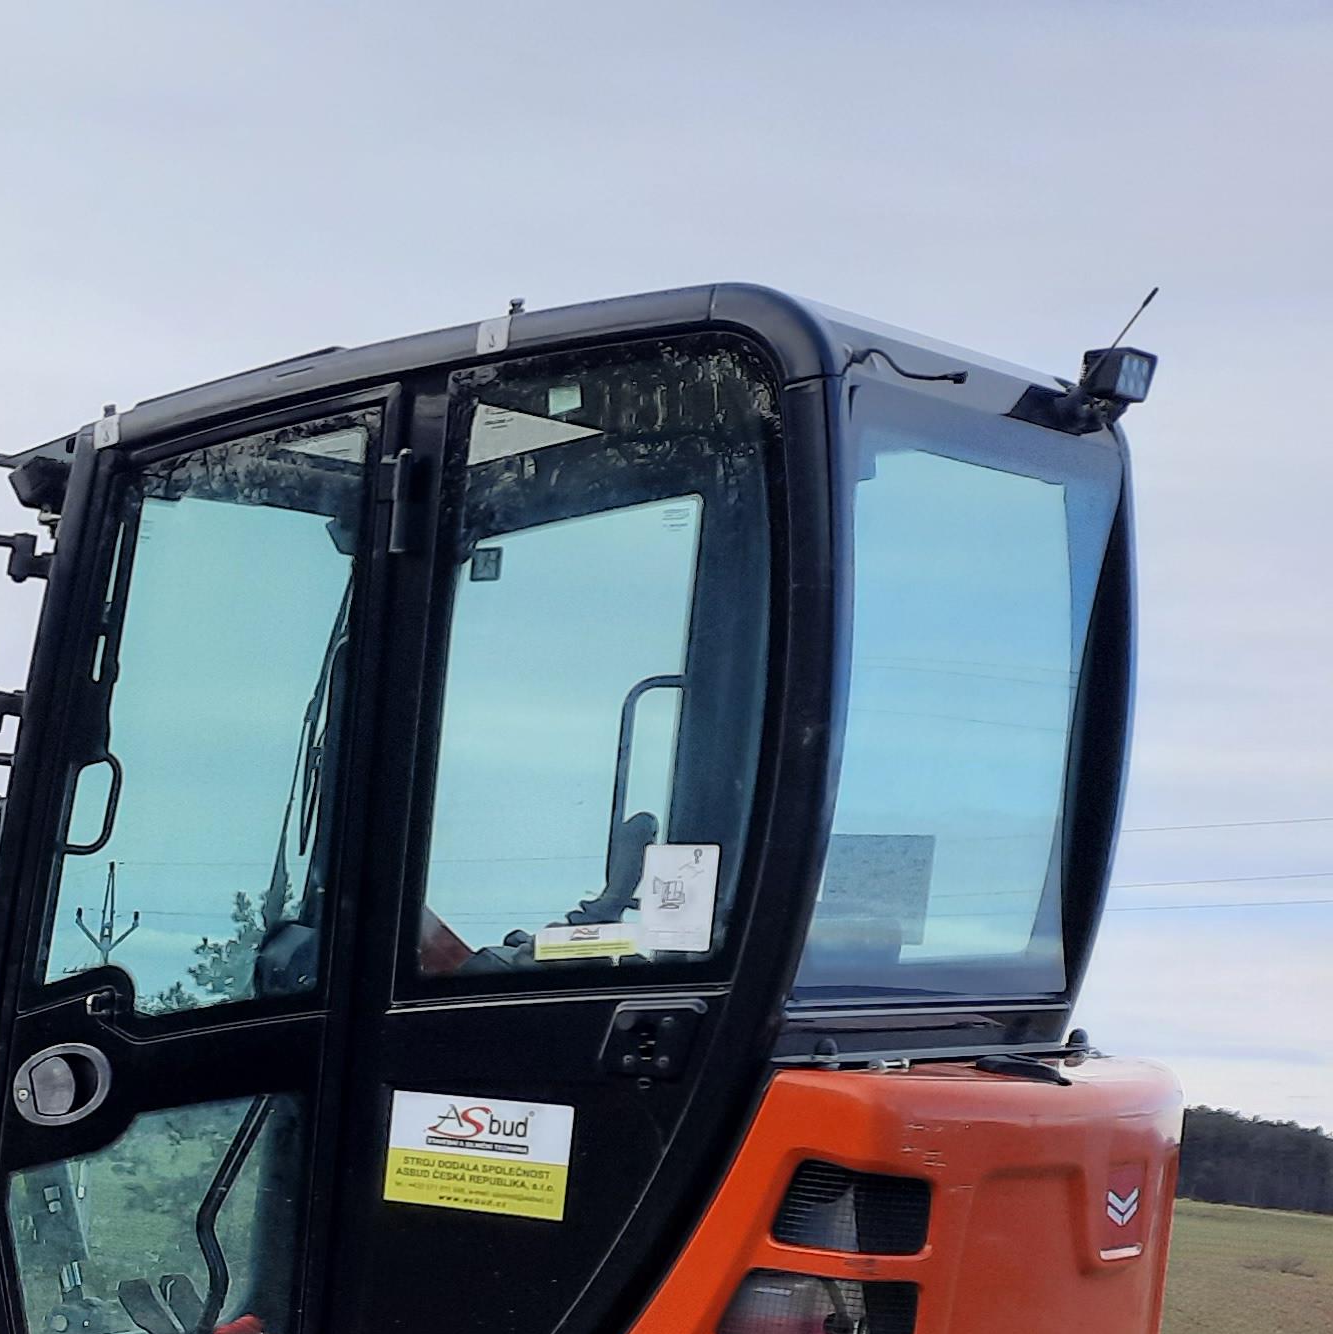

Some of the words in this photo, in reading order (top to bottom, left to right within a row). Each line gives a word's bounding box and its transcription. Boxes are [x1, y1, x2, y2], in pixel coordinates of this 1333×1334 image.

[396, 1167, 430, 1178] ASBUD
[403, 1156, 435, 1168] STROJ
[438, 1159, 480, 1173] DODALA
[482, 1163, 551, 1180] SPOLEČNOST
